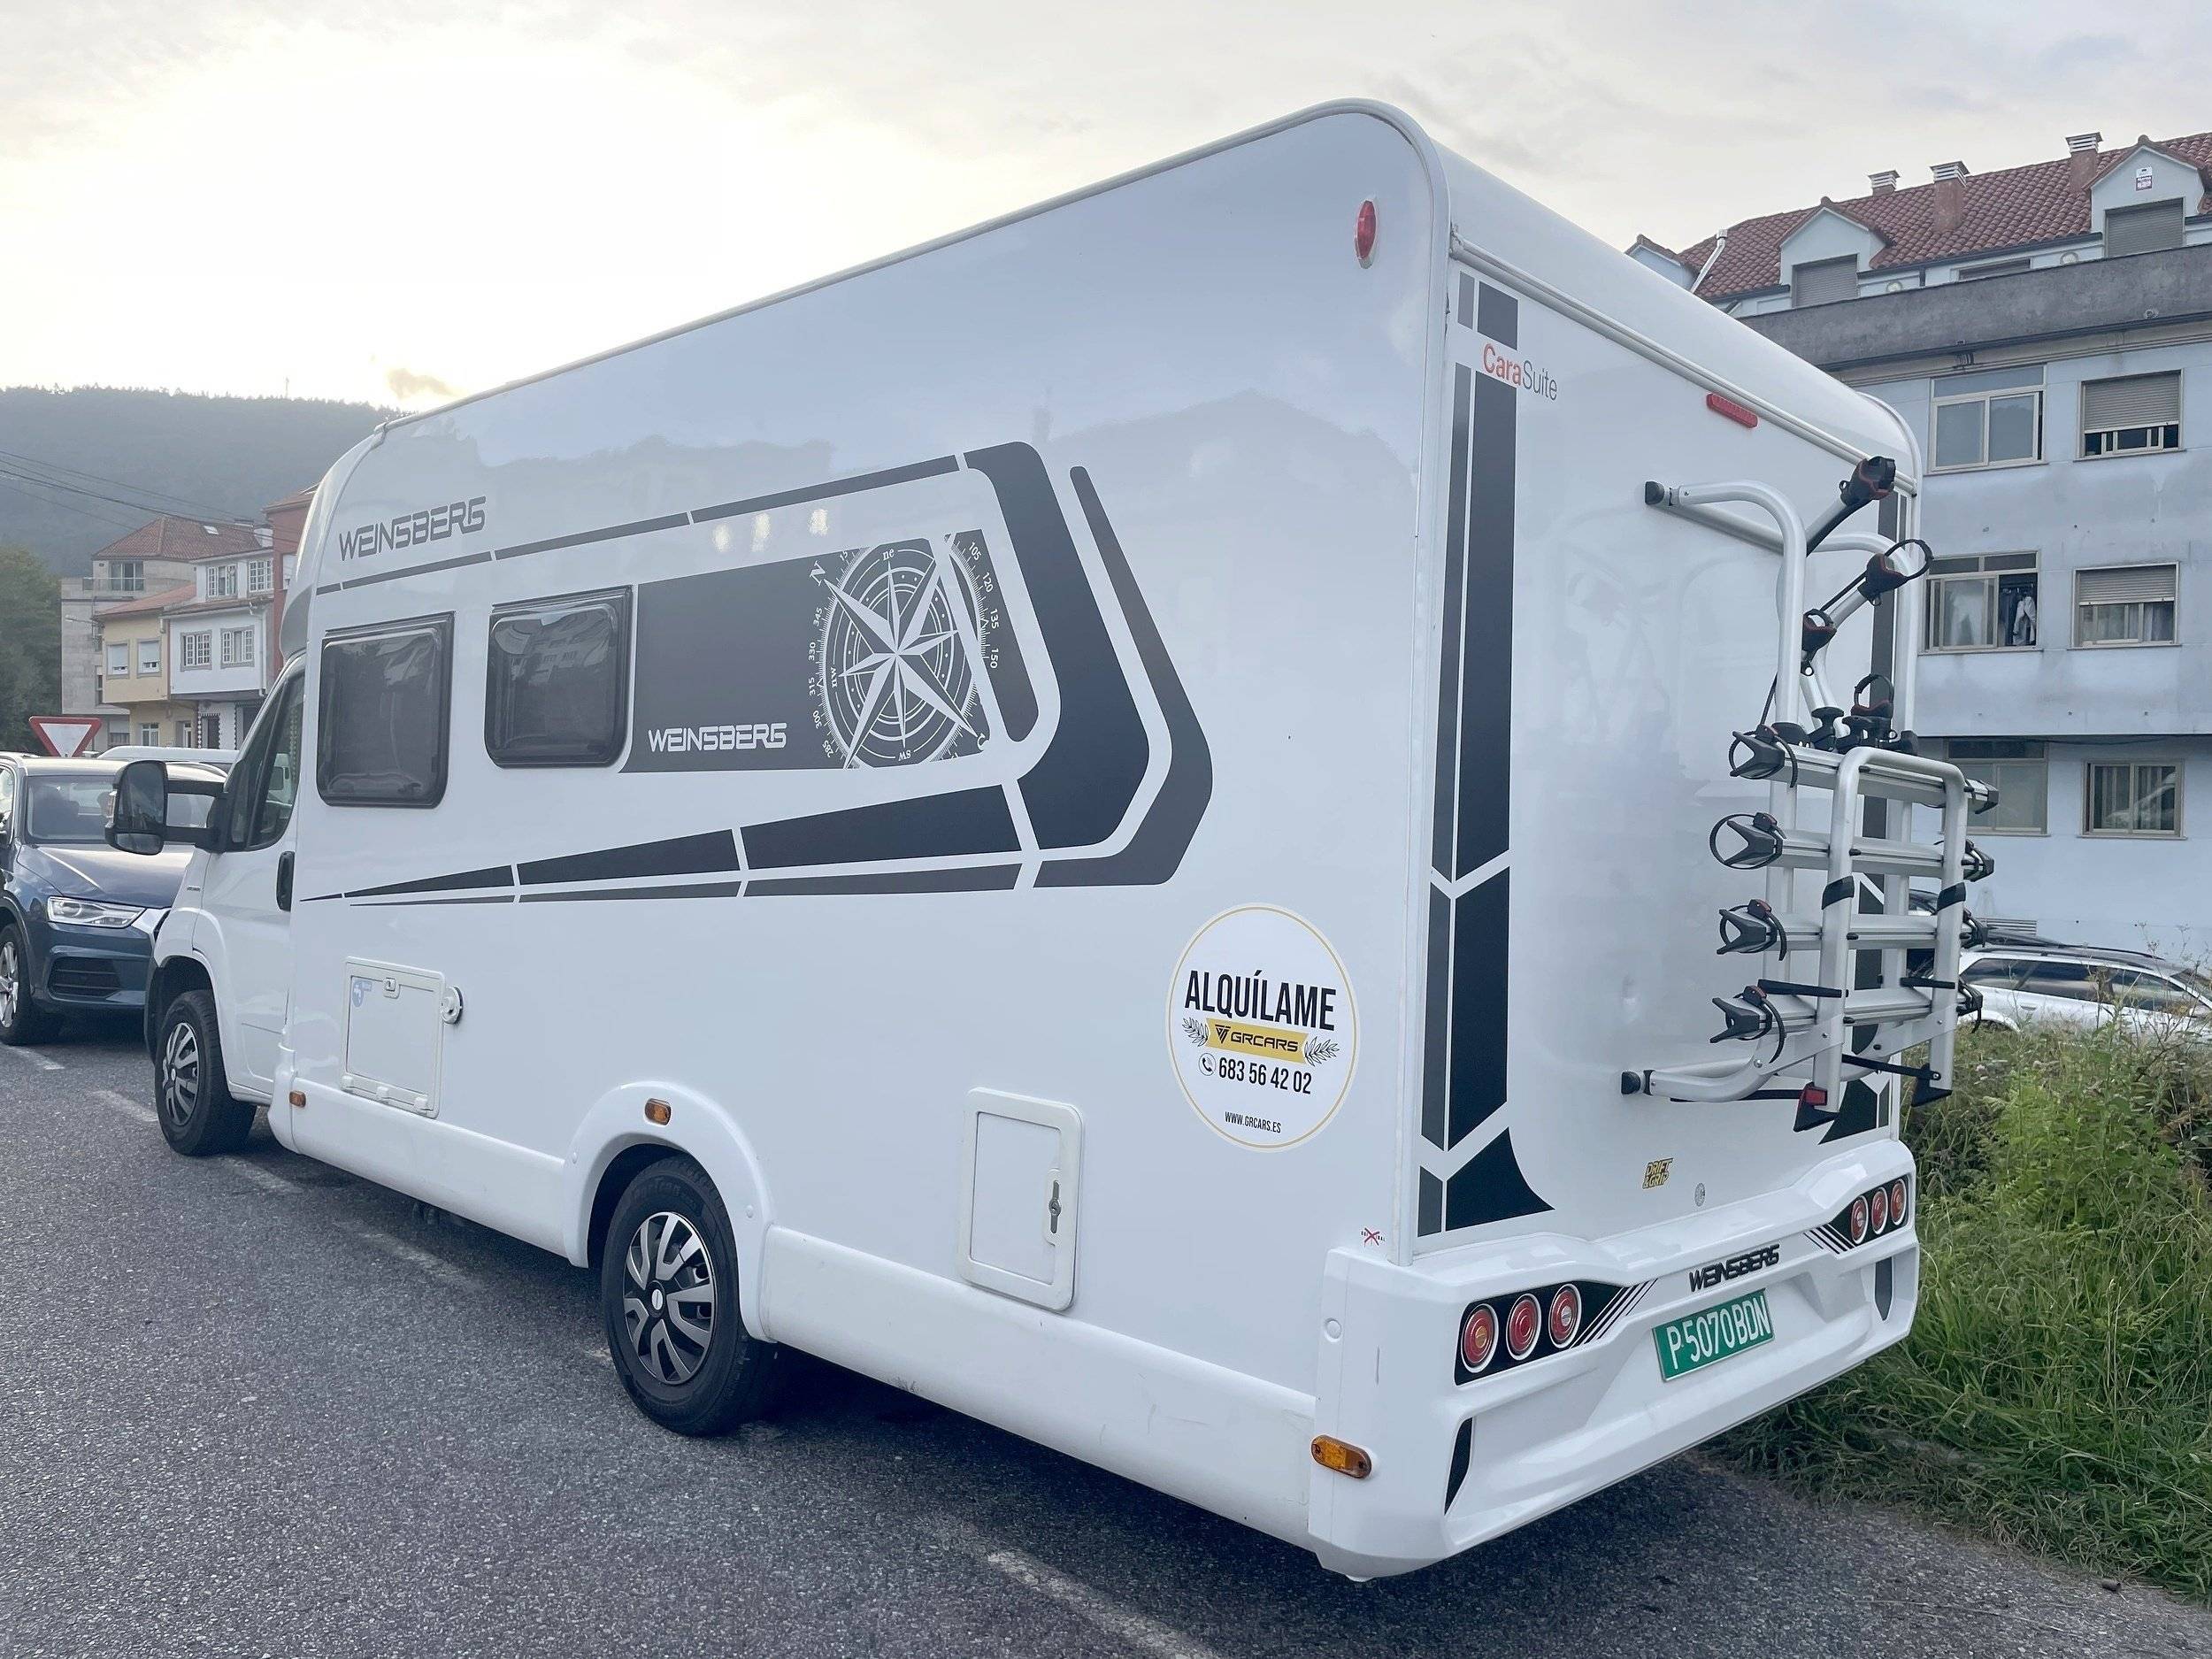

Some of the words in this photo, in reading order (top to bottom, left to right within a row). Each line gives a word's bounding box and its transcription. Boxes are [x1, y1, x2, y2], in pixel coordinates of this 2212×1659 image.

[1483, 343, 1557, 401] CaraSuite
[339, 495, 486, 562] WEINSBERG
[969, 542, 981, 561] 105
[982, 572, 994, 593] 120
[990, 608, 1000, 630] 135
[808, 641, 817, 661] 330
[990, 648, 999, 669] 150
[648, 722, 787, 752] WEINSBERG
[1184, 969, 1336, 1032] ALQUÍLAME
[1230, 1032, 1299, 1053] GRCARS
[1218, 1056, 1245, 1082] 683
[1248, 1062, 1267, 1087] 56
[1270, 1066, 1289, 1091] 42
[1293, 1070, 1312, 1095] 02
[1225, 1110, 1282, 1134] WWW.GRCARS.ES
[1688, 1243, 1781, 1293] WEINSBERG
